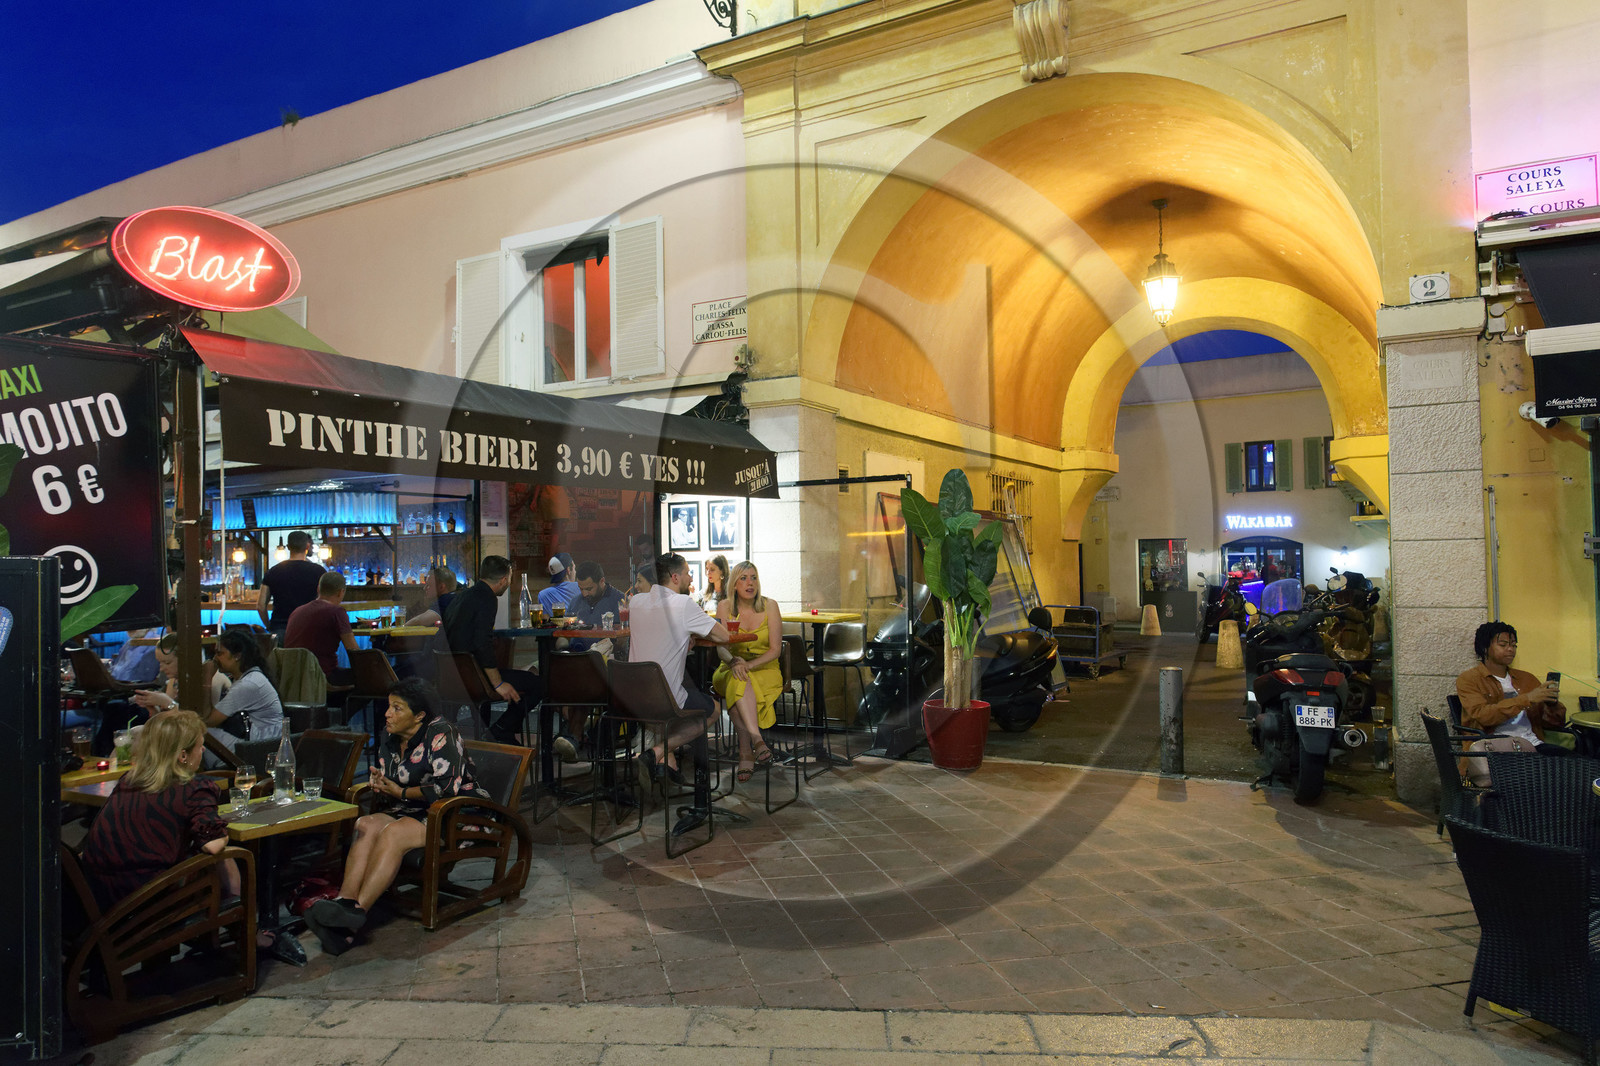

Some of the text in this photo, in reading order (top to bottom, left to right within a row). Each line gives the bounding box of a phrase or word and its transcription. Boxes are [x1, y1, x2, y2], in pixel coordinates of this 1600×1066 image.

[1508, 166, 1561, 182] COURS
[1506, 178, 1564, 195] SALEYA
[1529, 198, 1585, 215] COURS
[149, 235, 272, 292] Blast
[1423, 279, 1436, 297] 2
[709, 301, 732, 311] PLACE
[695, 328, 747, 340] CARLOU-FELIS
[707, 321, 734, 331] PLASSA
[0, 364, 43, 401] AXI
[266, 408, 706, 486] PINTHE BIERE 3,90 € YES !!!
[32, 463, 105, 515] 6 €
[1226, 515, 1293, 530] WAKABAR
[1307, 707, 1319, 716] FE
[1299, 716, 1332, 727] 888-PK
